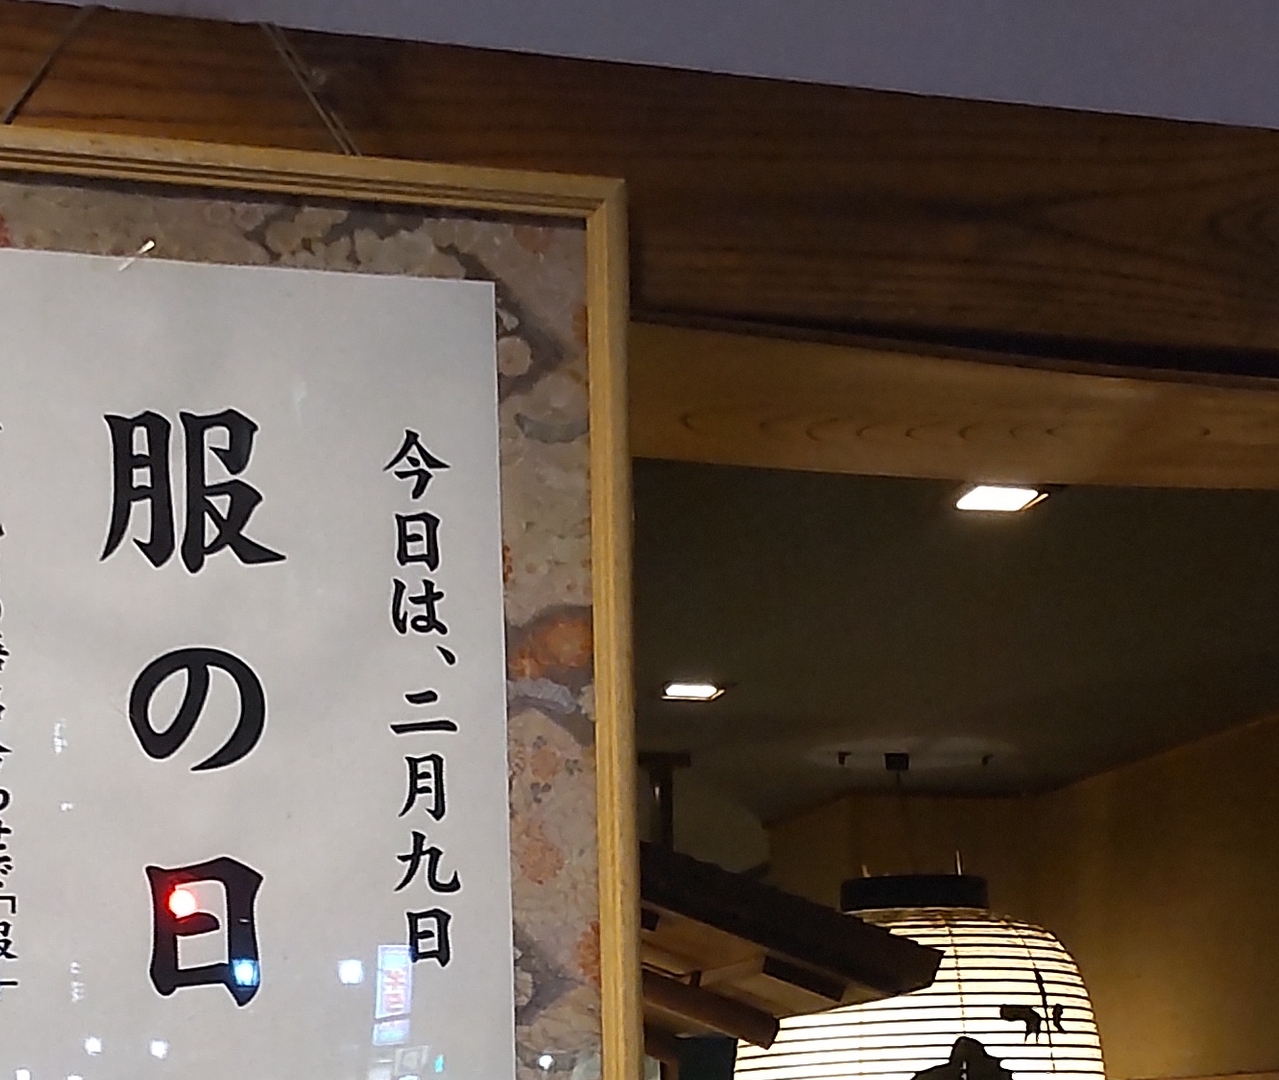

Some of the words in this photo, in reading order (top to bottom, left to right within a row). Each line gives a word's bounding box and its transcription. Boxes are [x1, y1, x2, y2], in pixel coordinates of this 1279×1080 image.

[100, 407, 286, 1008] 服の日
[384, 427, 461, 966] 今日は、二月九日
